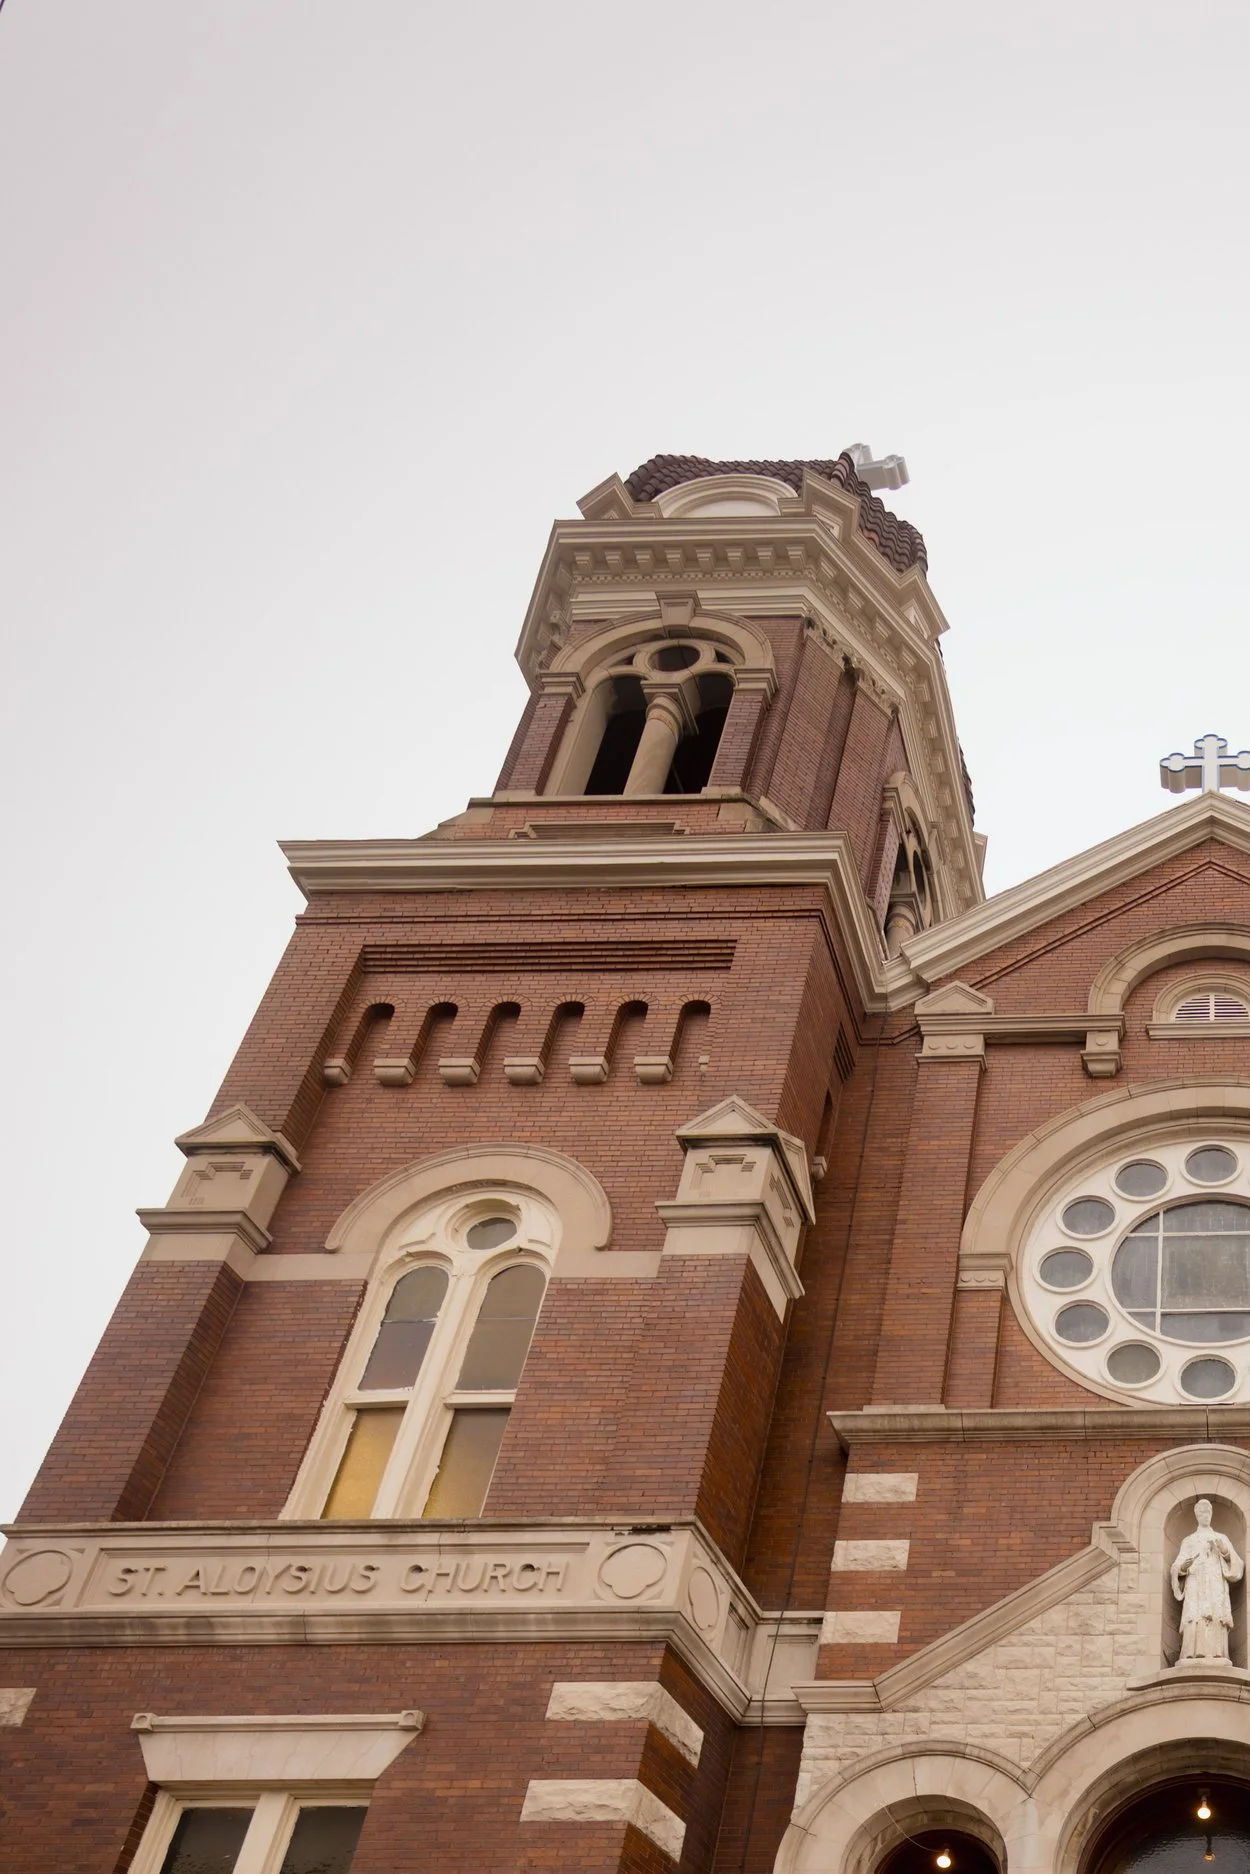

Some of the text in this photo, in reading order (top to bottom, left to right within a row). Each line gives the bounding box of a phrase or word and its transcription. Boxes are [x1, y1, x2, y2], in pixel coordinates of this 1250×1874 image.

[107, 1560, 568, 1597] ST. ALOYSIUS CHURCH
